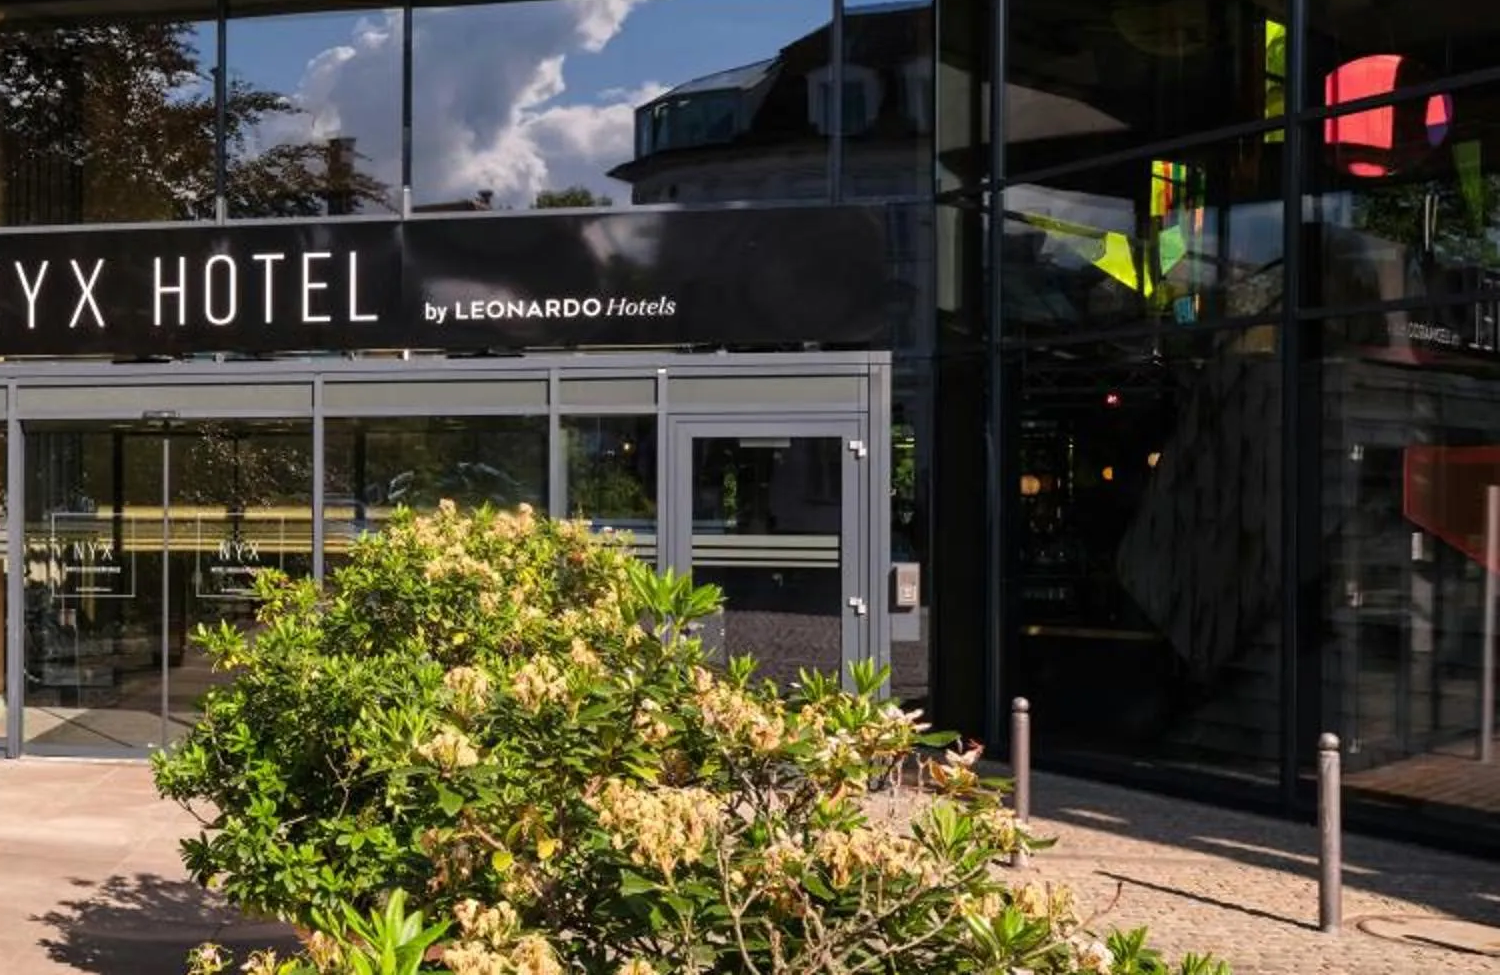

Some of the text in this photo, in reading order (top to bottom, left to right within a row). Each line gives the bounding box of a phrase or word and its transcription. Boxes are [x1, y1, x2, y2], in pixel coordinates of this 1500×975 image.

[153, 251, 378, 326] HOTEL
[424, 296, 677, 325] by LEONARDO Hotels
[73, 539, 114, 561] NYX
[219, 539, 261, 561] NYX
